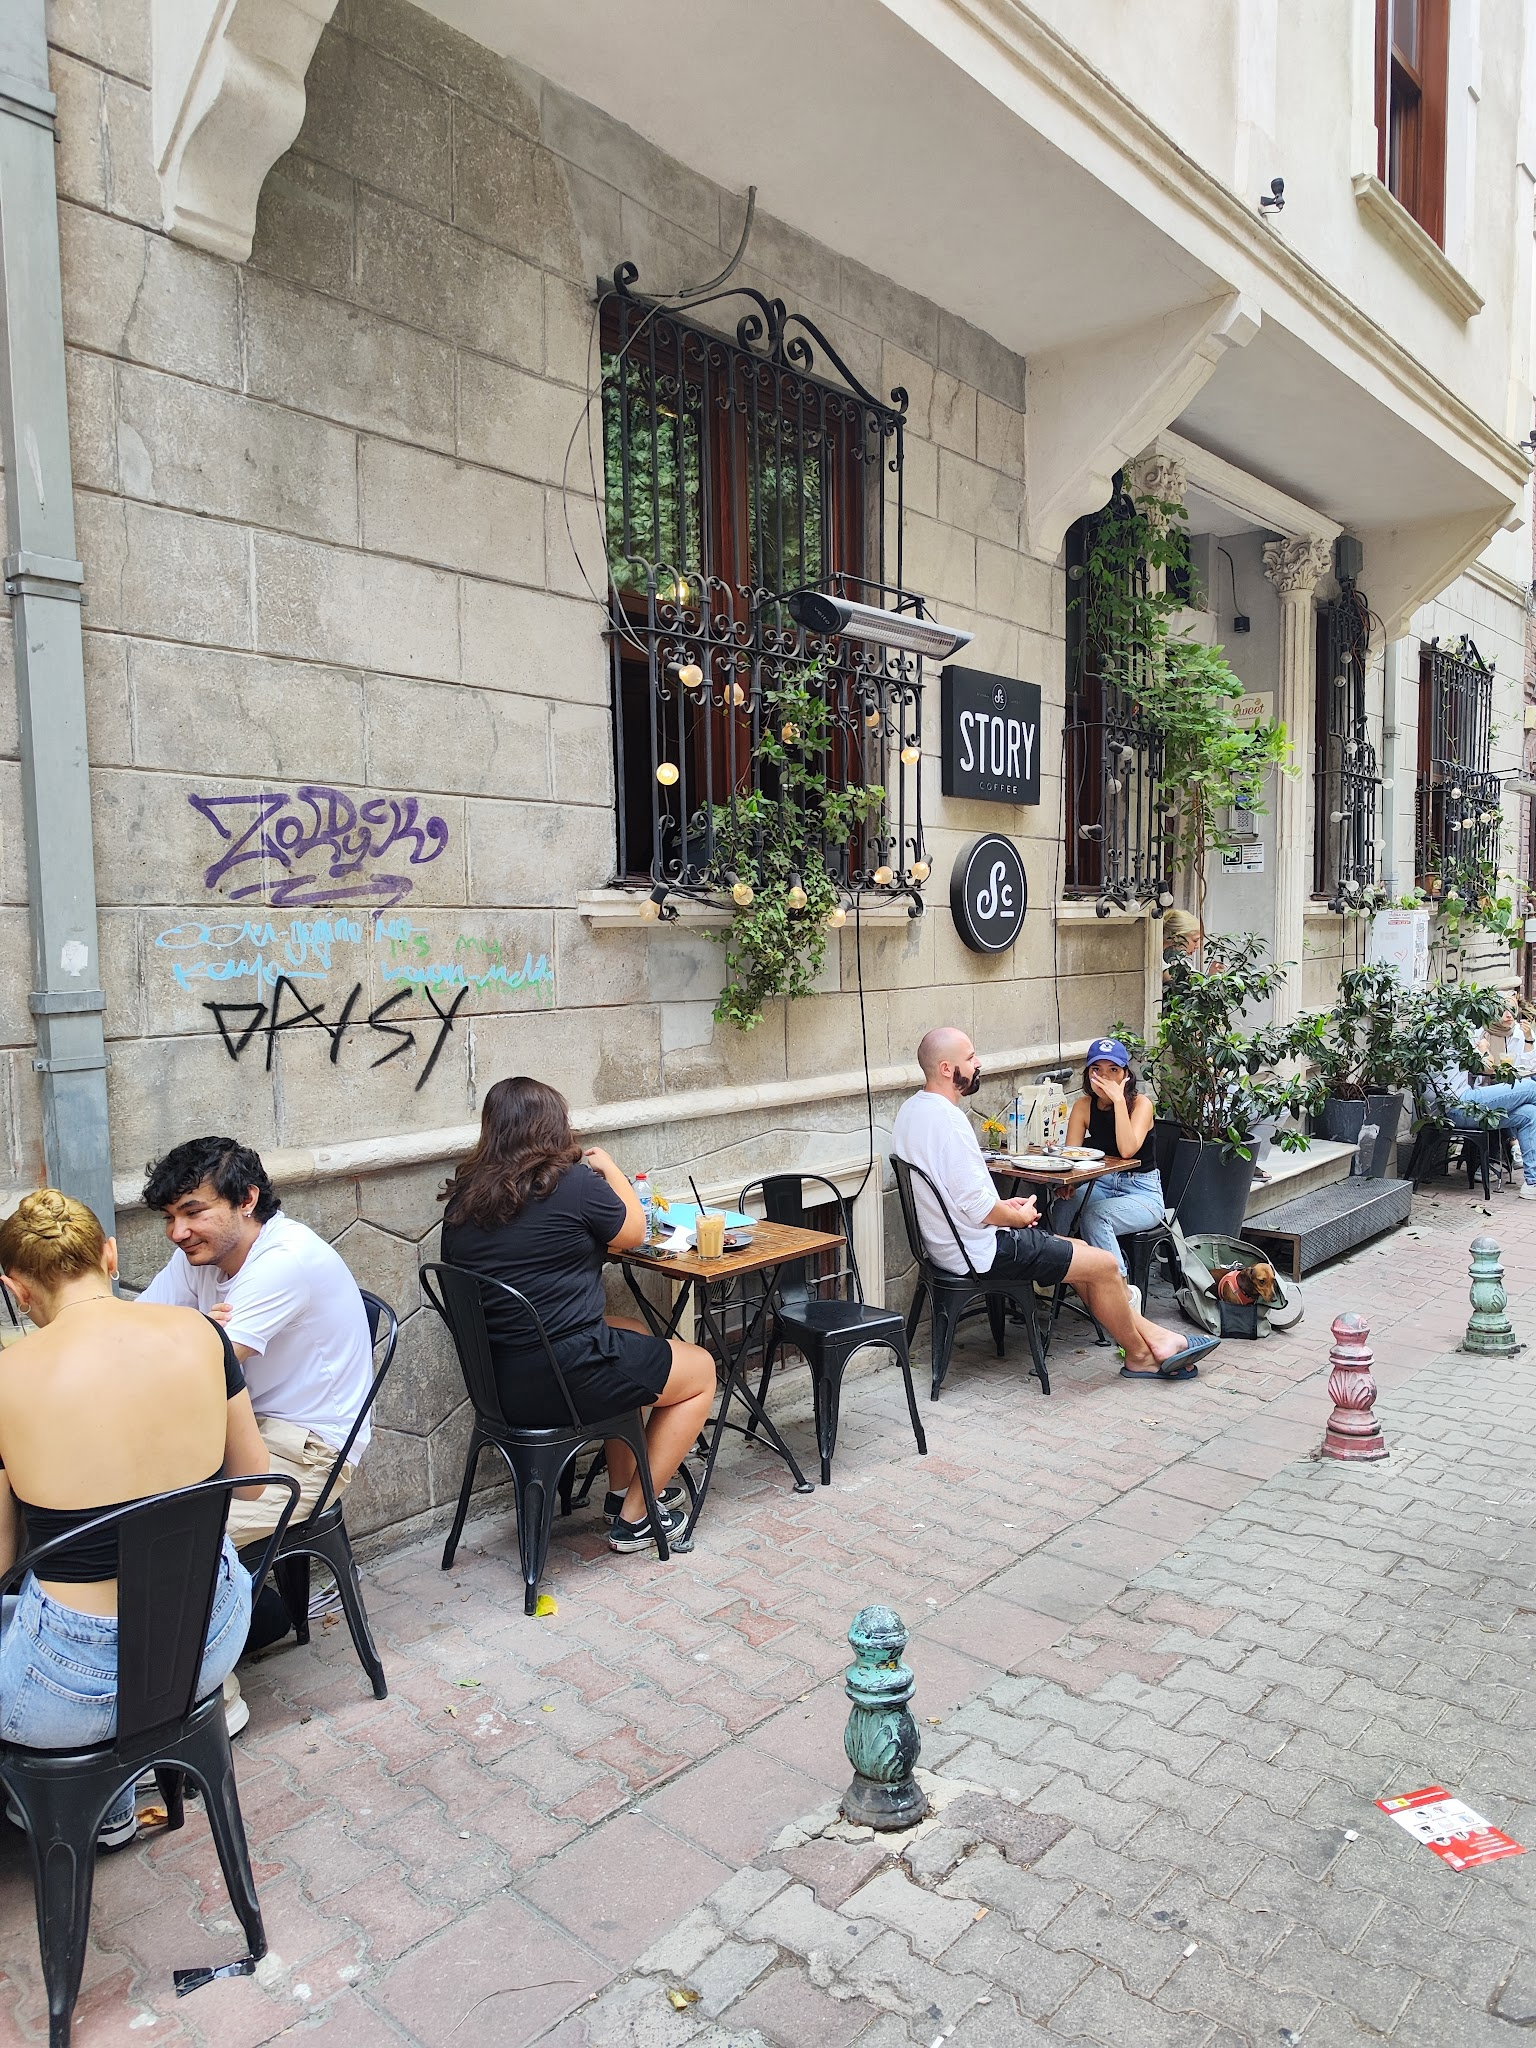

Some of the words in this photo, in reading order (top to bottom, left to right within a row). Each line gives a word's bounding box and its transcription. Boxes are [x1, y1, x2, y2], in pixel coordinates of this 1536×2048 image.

[959, 710, 1036, 780] STORY
[979, 781, 1018, 794] COFFEE
[202, 975, 469, 1092] DAISY
